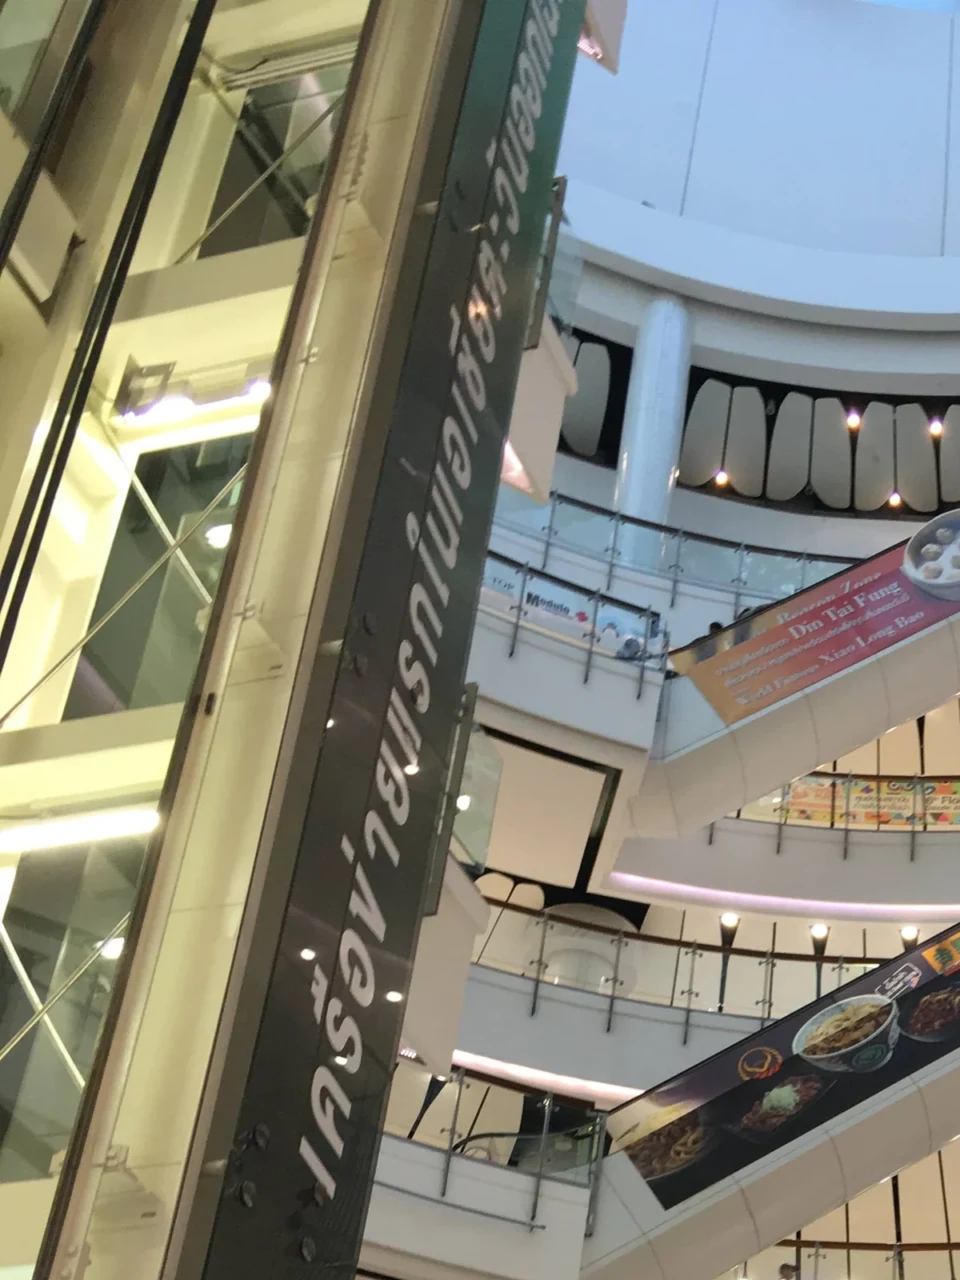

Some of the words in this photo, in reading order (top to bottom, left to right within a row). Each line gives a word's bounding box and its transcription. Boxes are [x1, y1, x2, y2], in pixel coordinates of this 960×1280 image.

[788, 618, 824, 640] Din
[821, 600, 855, 622] Tai
[853, 581, 902, 609] Fung
[819, 640, 857, 666] Xiao
[856, 627, 897, 648] Long
[895, 611, 925, 629] Bao
